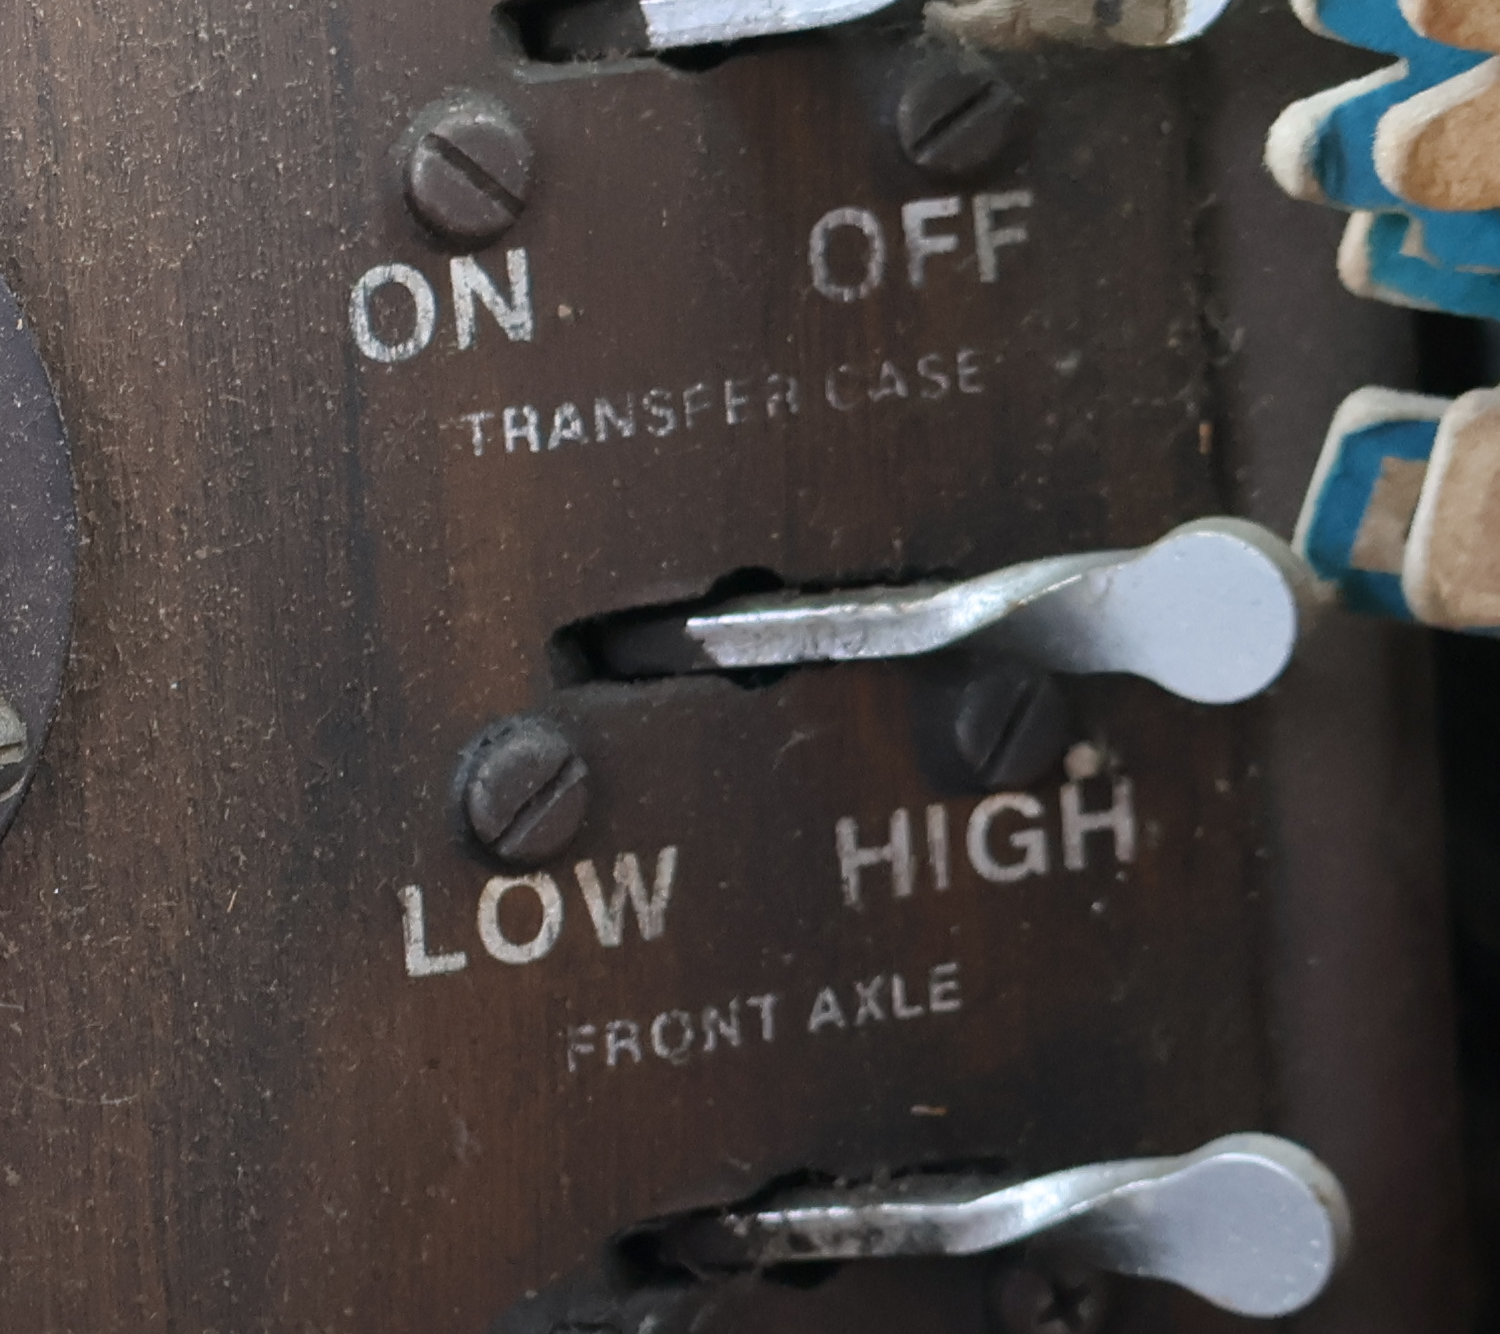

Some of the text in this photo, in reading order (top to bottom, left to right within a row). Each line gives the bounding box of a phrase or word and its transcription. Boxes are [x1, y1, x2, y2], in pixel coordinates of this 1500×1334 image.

[349, 191, 1034, 364] ON OFF
[462, 348, 985, 457] TRANSFER CASE
[401, 775, 1136, 978] LOW HIGH
[568, 962, 963, 1073] FRONT AXLE
